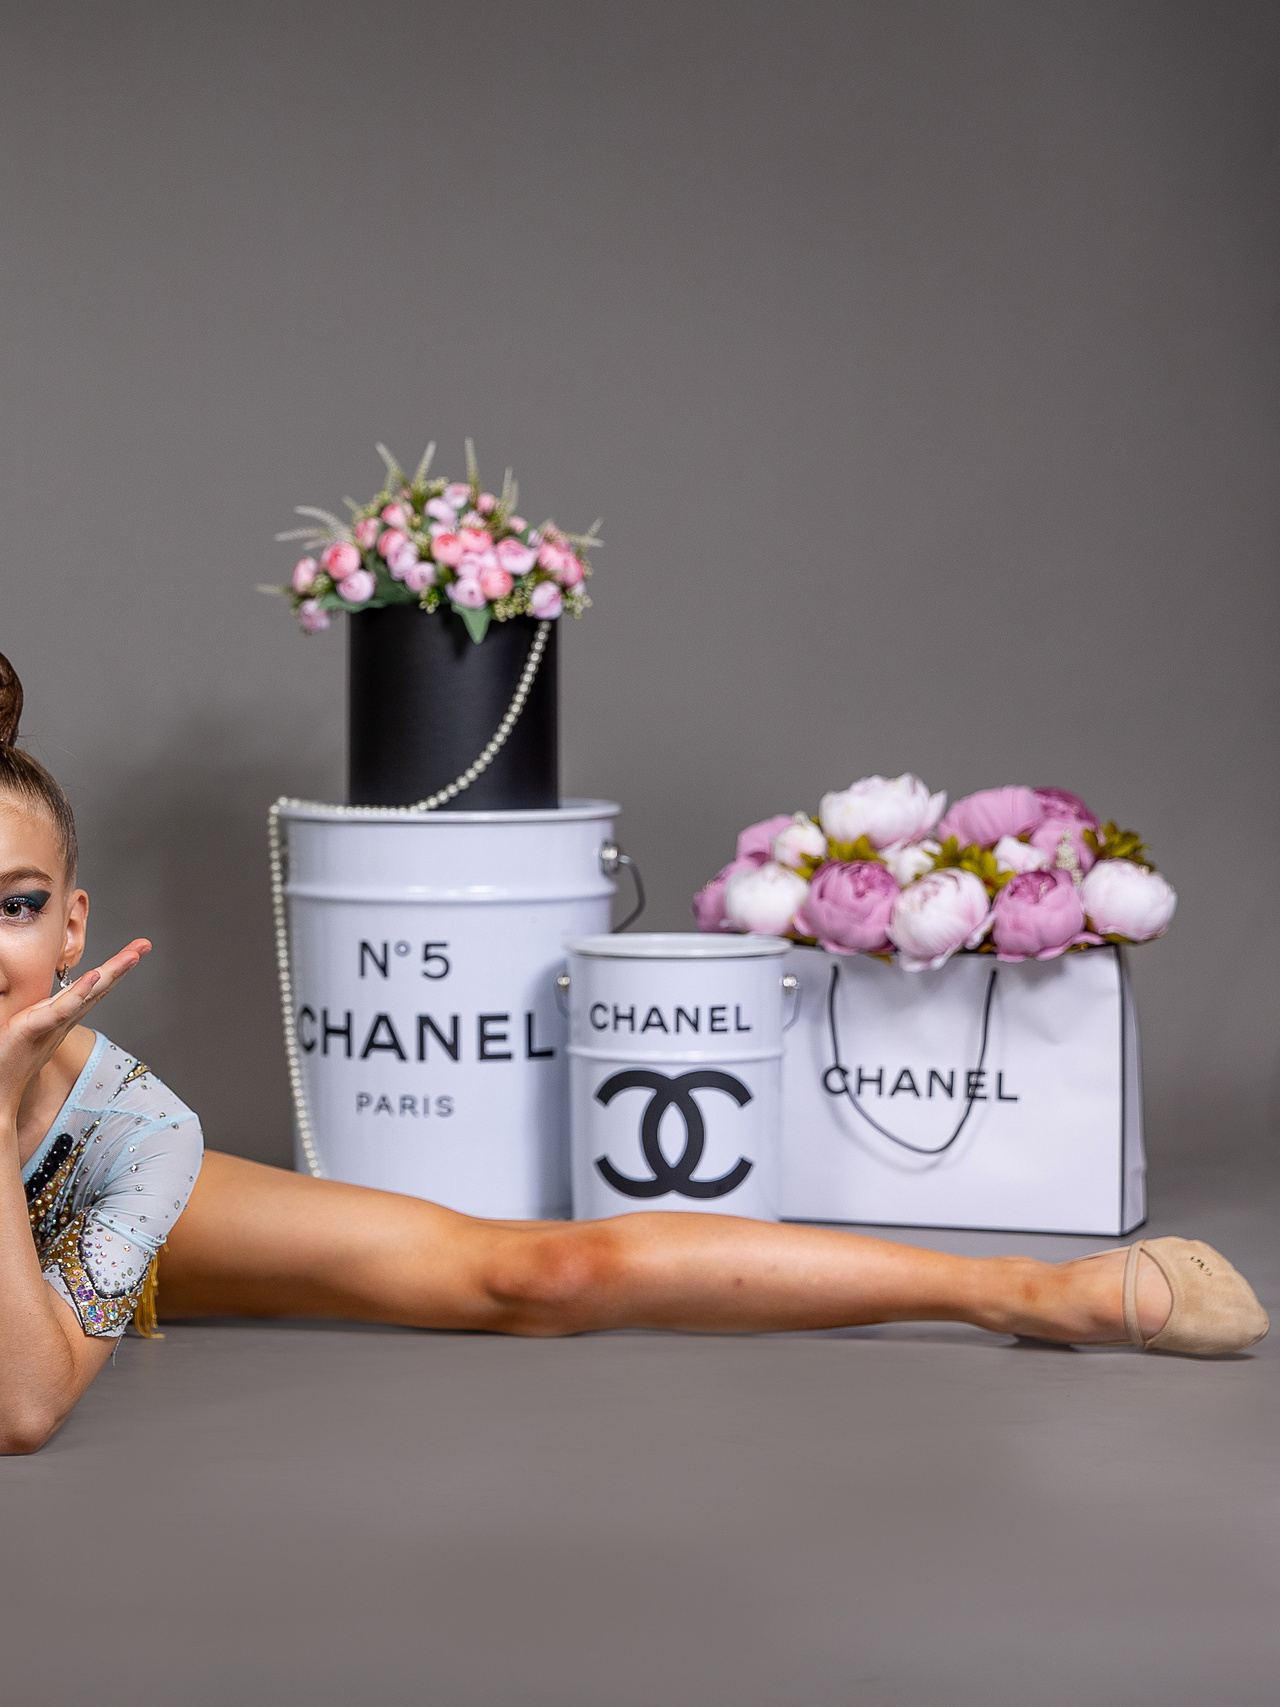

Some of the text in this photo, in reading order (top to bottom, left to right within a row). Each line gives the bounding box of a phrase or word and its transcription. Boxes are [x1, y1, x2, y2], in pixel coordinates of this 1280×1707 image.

[297, 1006, 555, 1061] CHANEL
[590, 1003, 753, 1034] CHANEL
[823, 1065, 1019, 1101] CHANEL
[356, 1093, 455, 1118] PARIS
